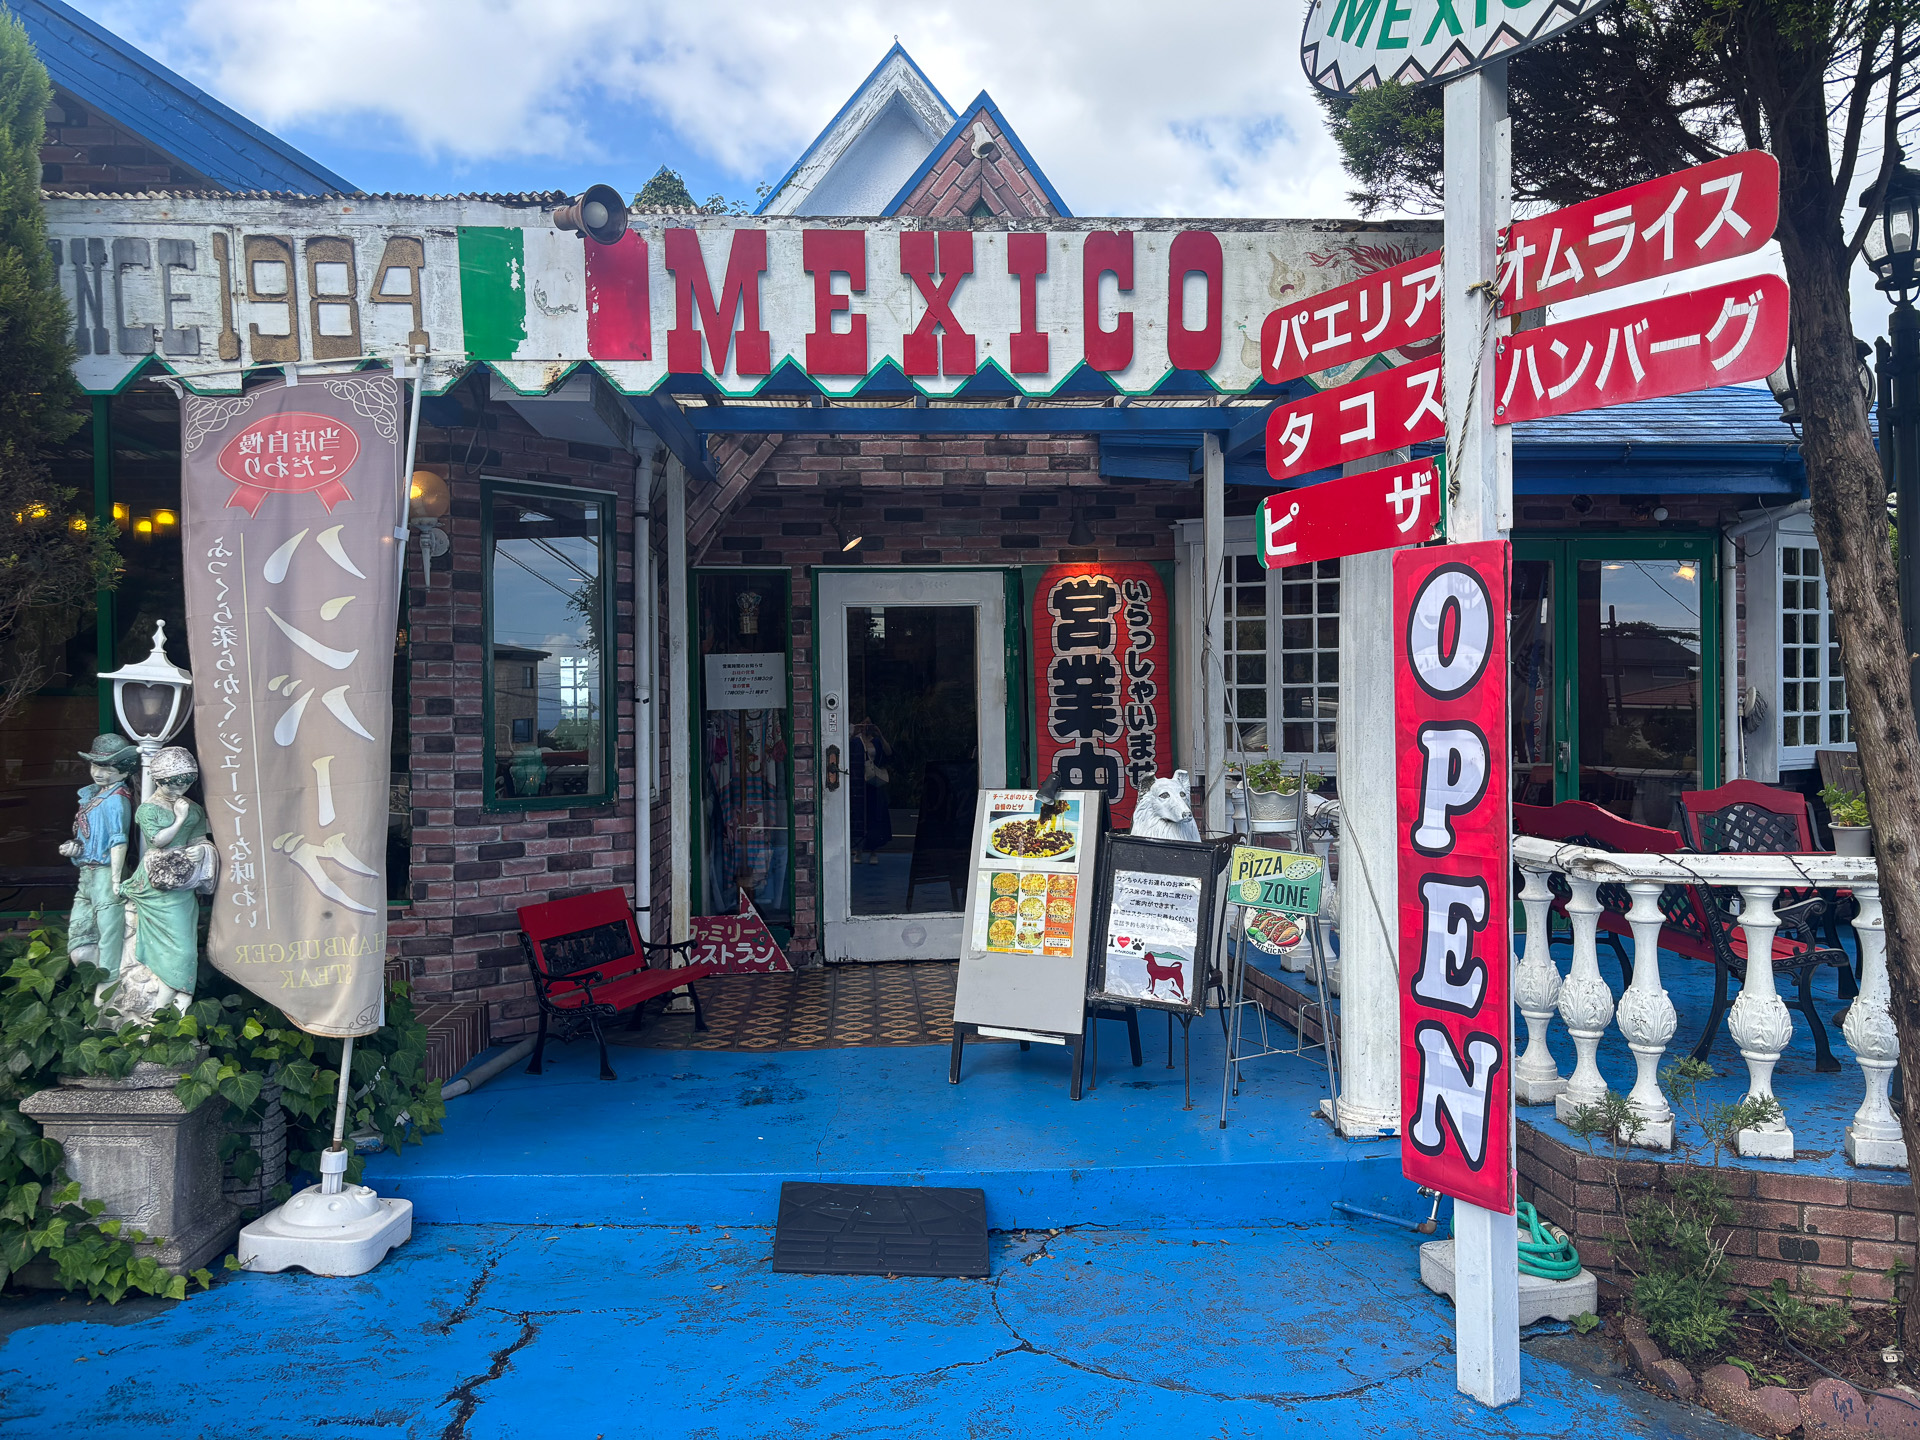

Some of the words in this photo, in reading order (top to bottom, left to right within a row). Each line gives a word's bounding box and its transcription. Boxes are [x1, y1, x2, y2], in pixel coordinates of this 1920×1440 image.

[1497, 172, 1752, 300] オムライス
[213, 232, 430, 361] 1984
[665, 228, 1223, 376] MEXICO
[1272, 264, 1441, 370] パエリア
[1500, 288, 1765, 407] ハンバーグ
[1278, 367, 1443, 467] タコス
[1050, 577, 1122, 802] 営業中
[993, 793, 1034, 801] チーズがのびる
[1239, 855, 1283, 880] PIZZA
[1263, 882, 1310, 908] ZONE
[1405, 561, 1502, 1172] OPEN
[688, 922, 757, 943] ファミリー
[1254, 942, 1288, 954] MEXICAN
